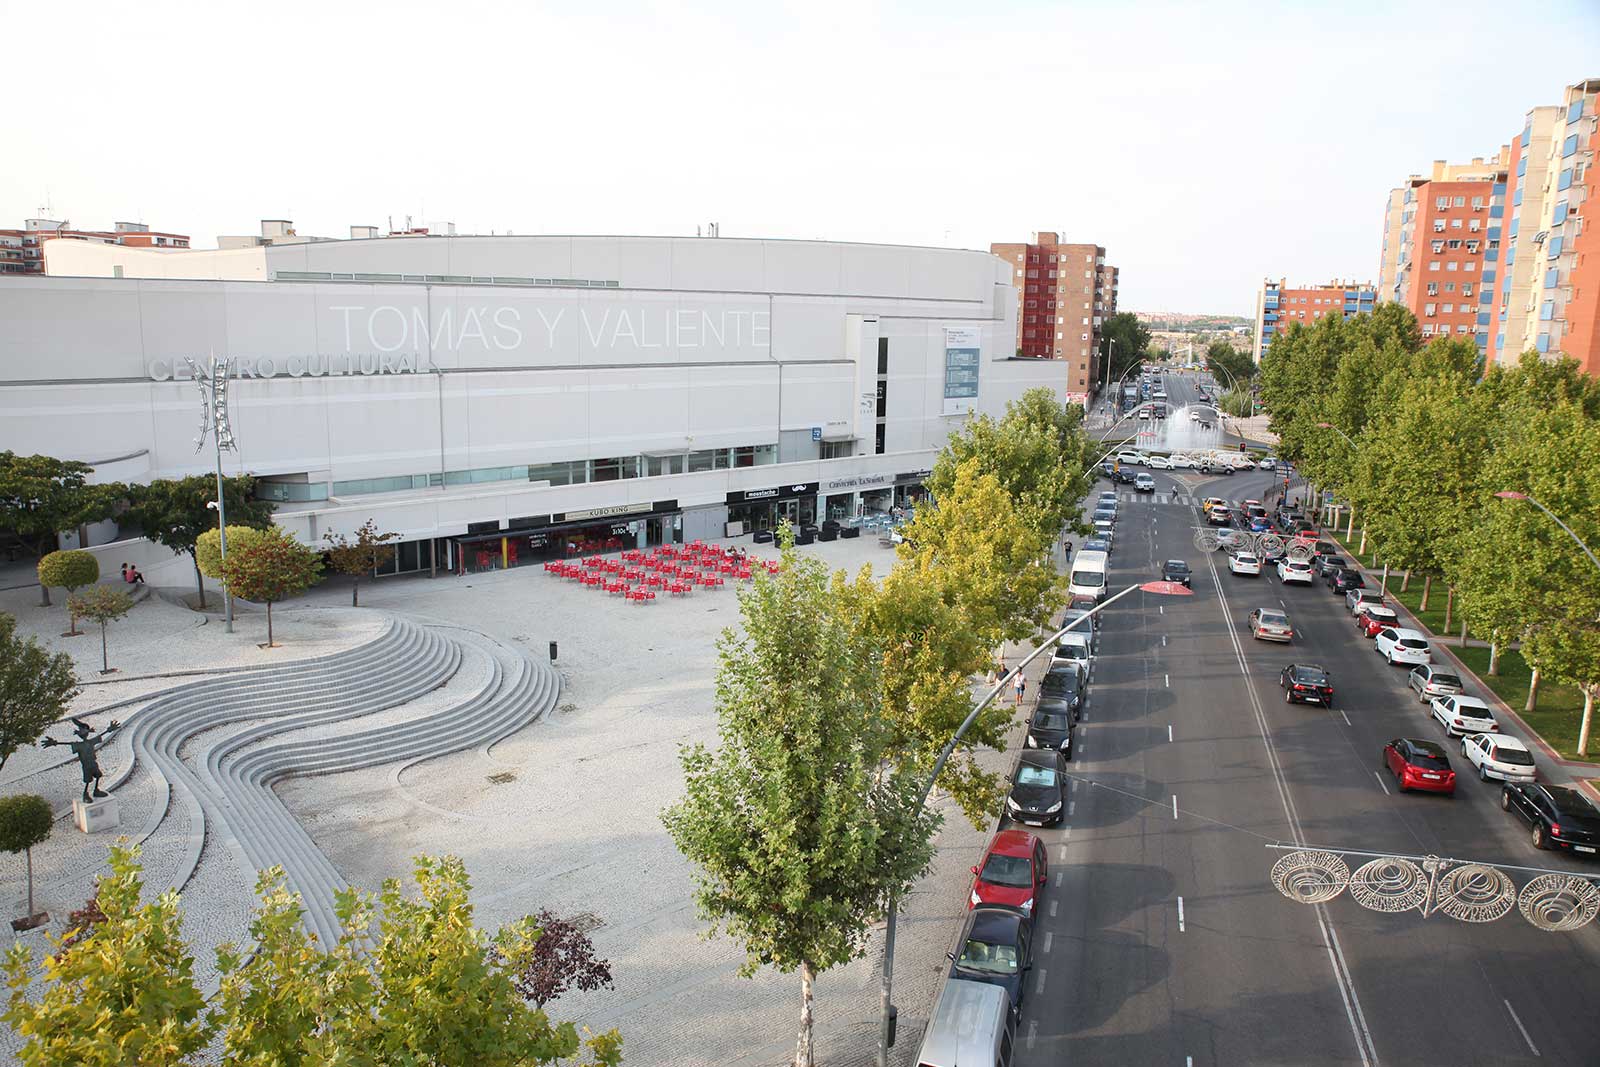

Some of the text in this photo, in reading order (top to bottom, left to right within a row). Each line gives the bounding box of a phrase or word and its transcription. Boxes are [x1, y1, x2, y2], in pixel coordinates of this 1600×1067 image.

[328, 305, 771, 352] TOMÁS Y VALIENTE
[285, 352, 431, 377] CULTURAL
